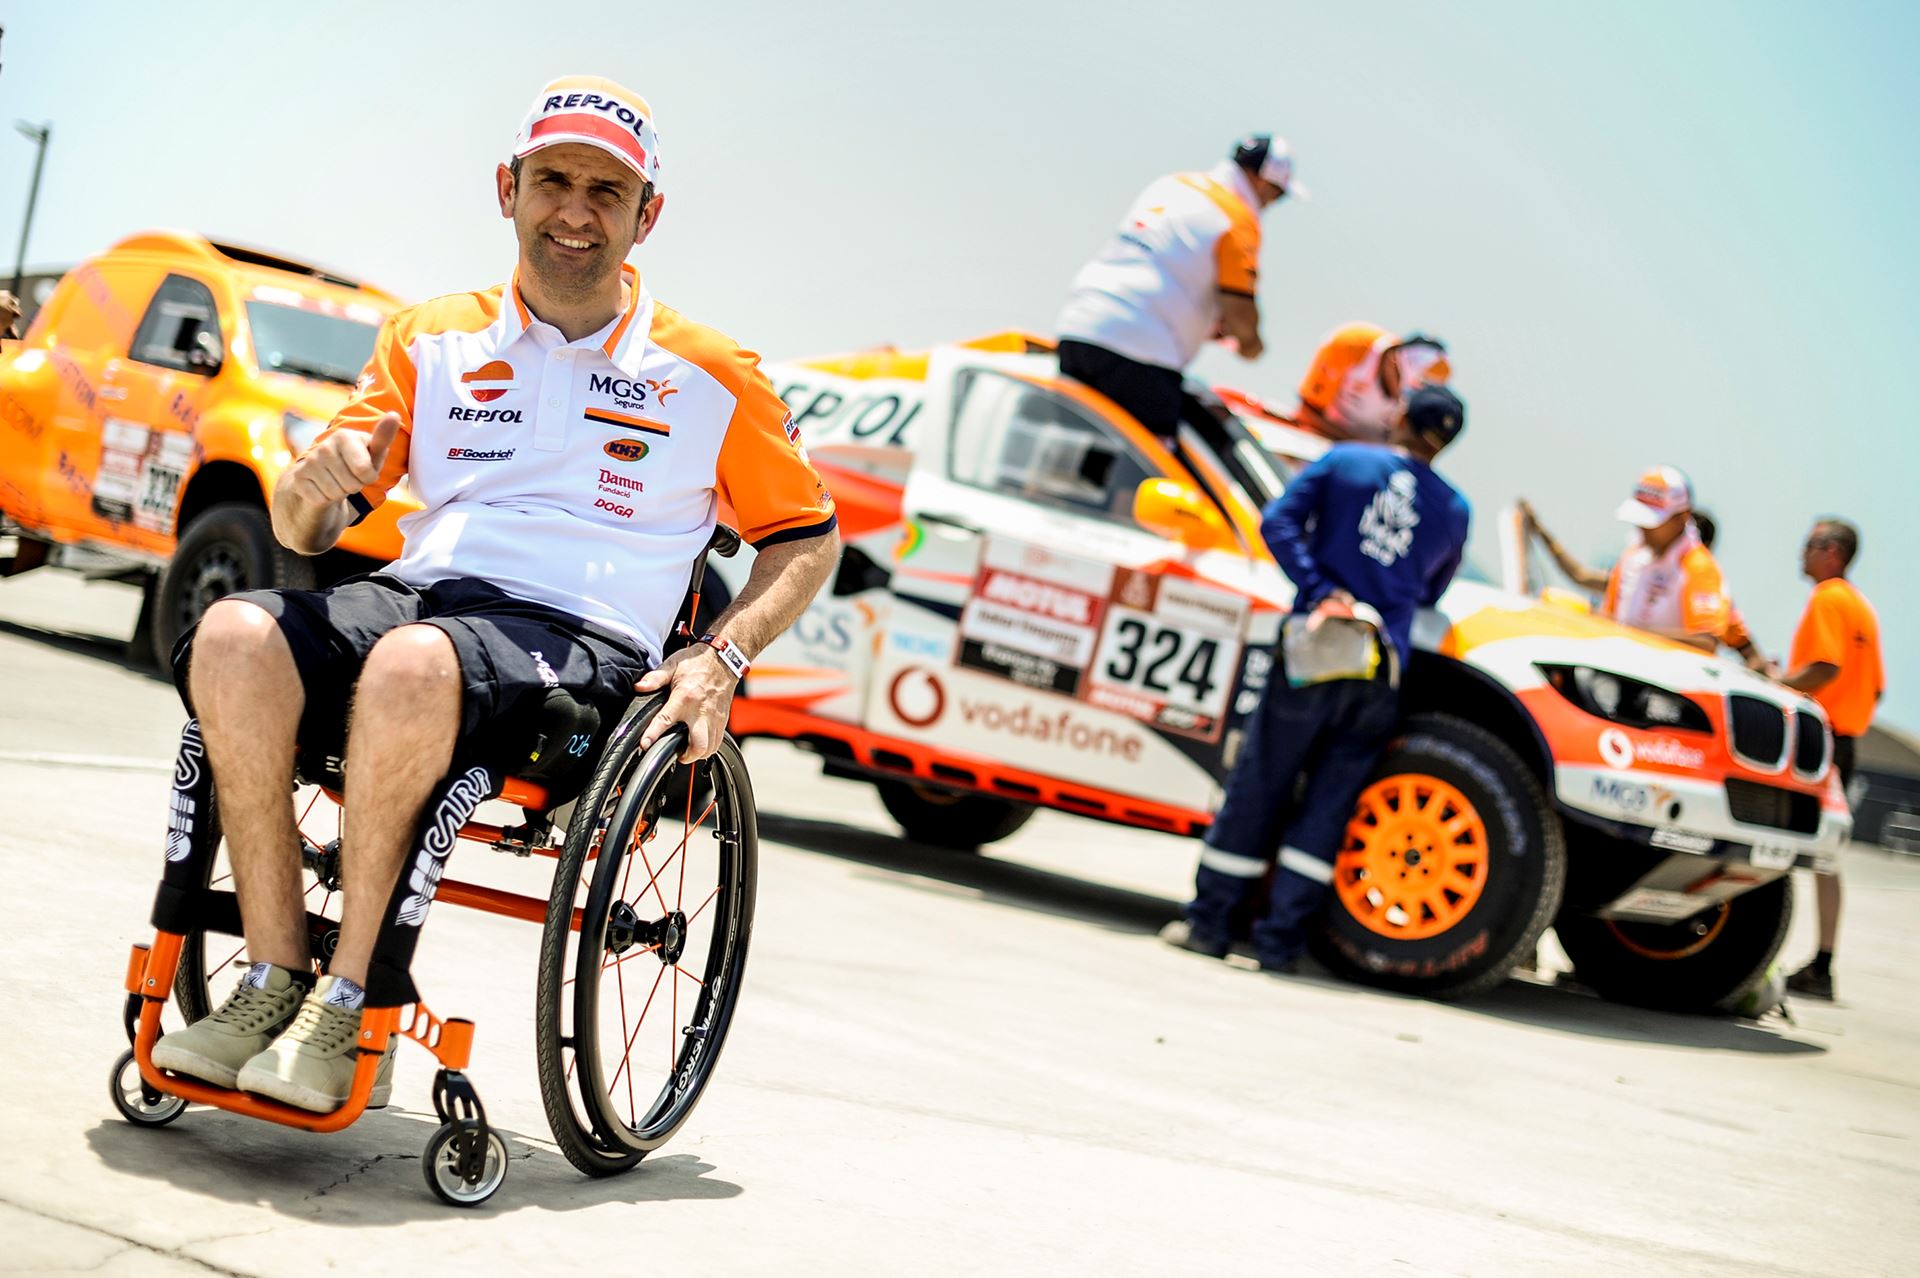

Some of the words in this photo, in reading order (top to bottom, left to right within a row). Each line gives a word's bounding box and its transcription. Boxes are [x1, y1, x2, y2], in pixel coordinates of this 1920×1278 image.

[542, 93, 647, 137] REPSOL
[589, 373, 646, 401] MGS
[448, 406, 523, 424] REPSOL
[613, 397, 645, 410] Seguros
[447, 447, 515, 460] BFGoodrich
[598, 468, 644, 493] Damm
[593, 498, 635, 519] DOGA
[1106, 618, 1220, 702] 324
[959, 697, 1146, 763] vodafone
[1634, 737, 1705, 768] vodafone
